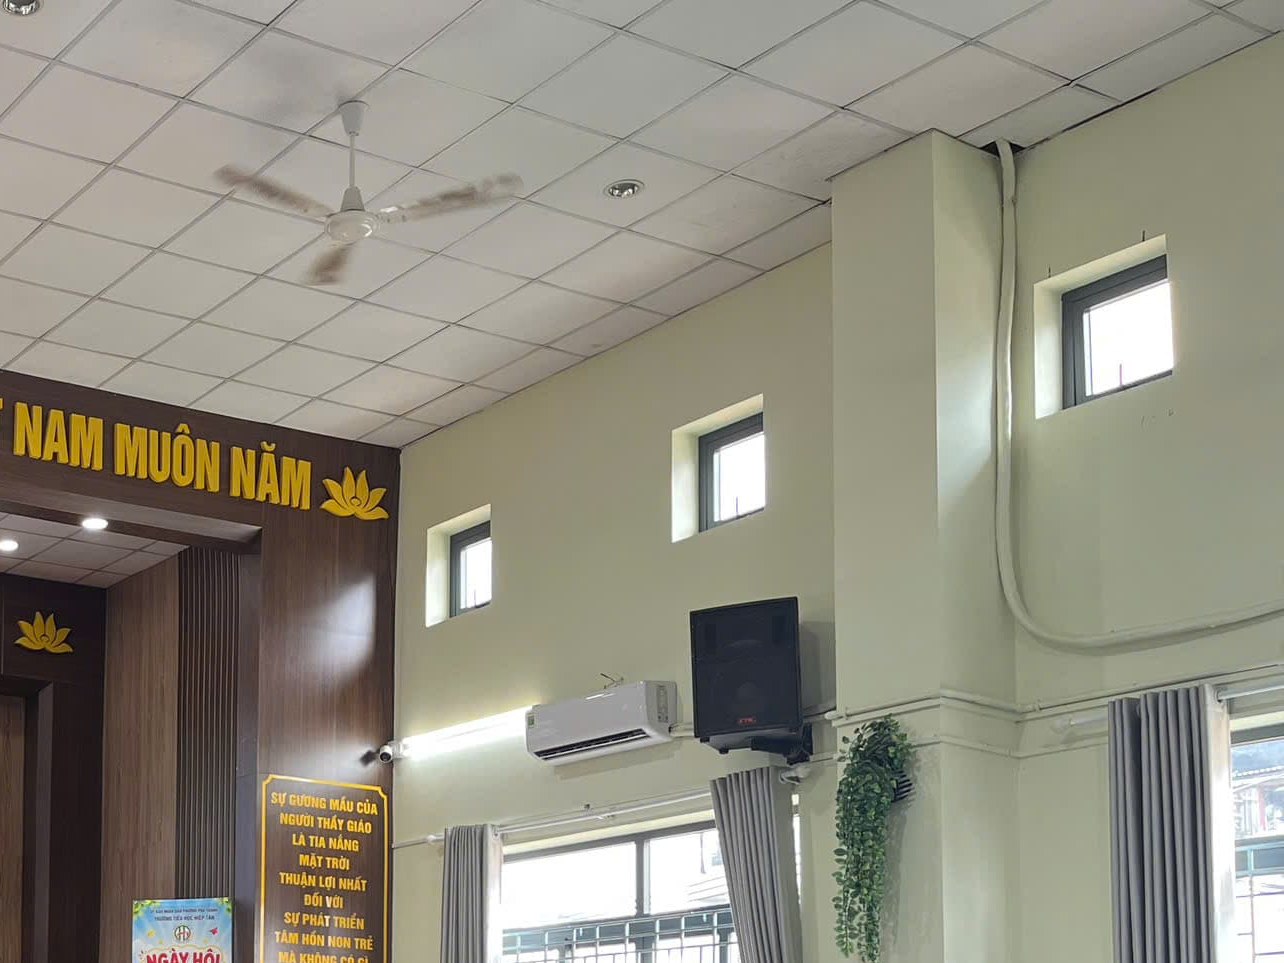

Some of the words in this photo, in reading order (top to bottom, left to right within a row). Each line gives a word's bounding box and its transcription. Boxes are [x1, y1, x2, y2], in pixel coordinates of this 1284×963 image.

[14, 402, 103, 471] NAM
[115, 424, 219, 492] MUÔN
[230, 443, 311, 510] NĂM
[271, 792, 287, 807] SỰ
[356, 799, 378, 815] CỦA
[346, 819, 372, 834] GIÁO
[309, 835, 326, 848] TIA
[279, 872, 316, 888] THUẬN
[319, 875, 335, 890] LỢI
[338, 875, 367, 891] NHẤT
[284, 912, 301, 927] SỰ
[302, 912, 330, 927] PHÁT
[275, 930, 299, 944] TÂM
[327, 935, 351, 949] NON
